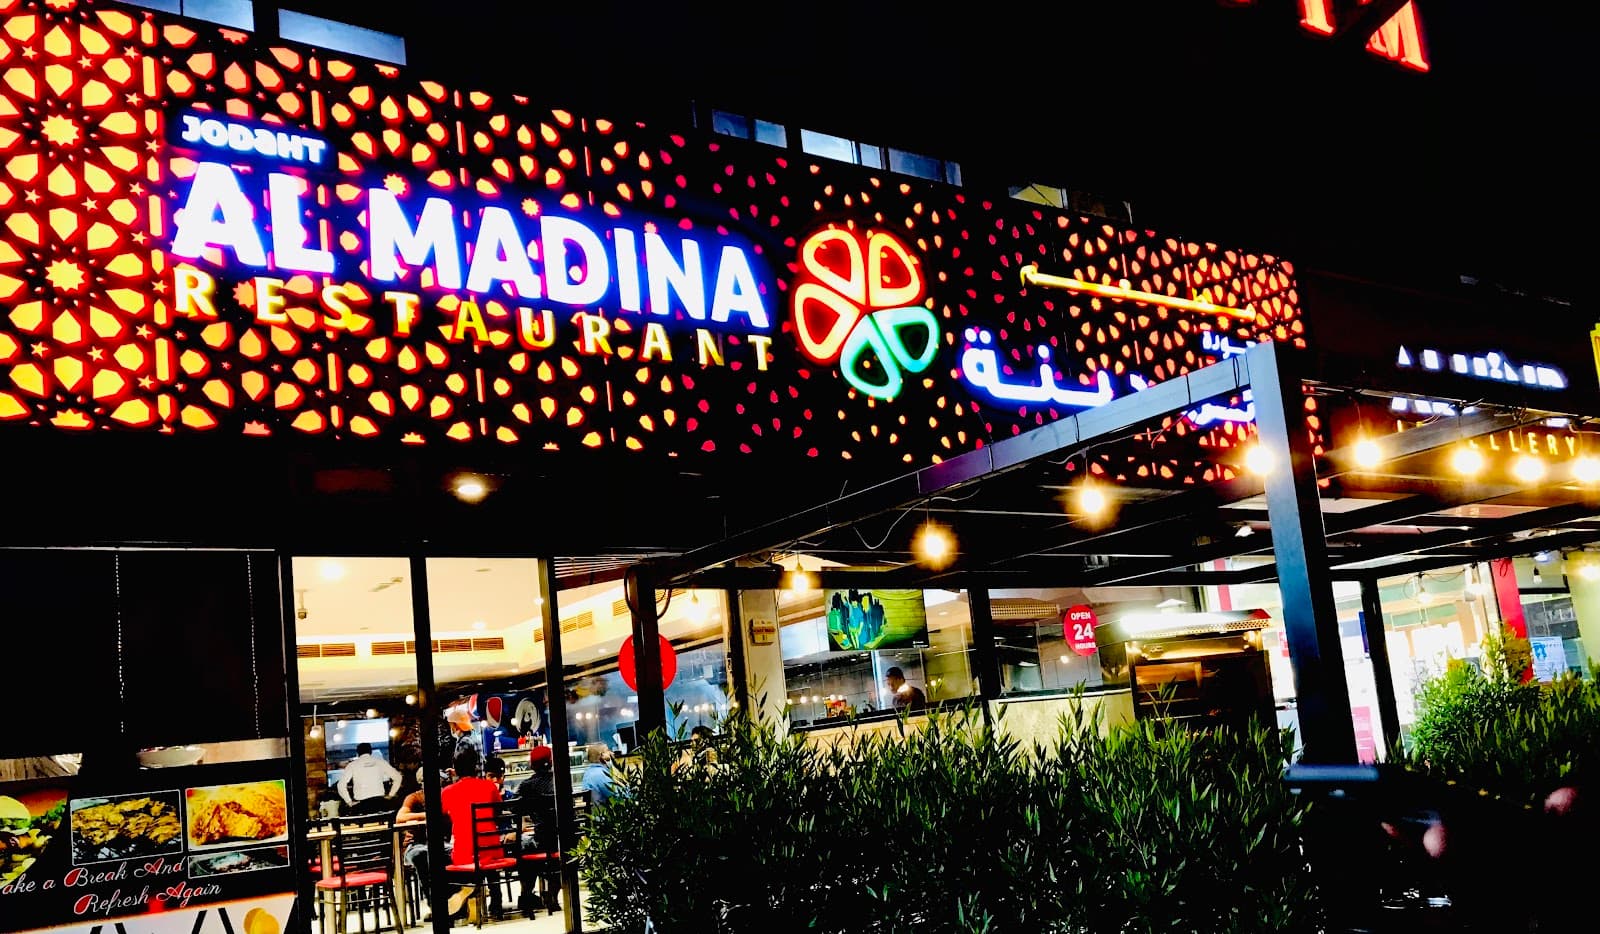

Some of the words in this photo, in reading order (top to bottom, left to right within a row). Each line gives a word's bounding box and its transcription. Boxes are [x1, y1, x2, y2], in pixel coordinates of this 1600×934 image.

[171, 160, 336, 274] AL
[368, 188, 770, 328] MADINA
[171, 267, 773, 372] RESTAURANT
[1070, 611, 1091, 620] OPEN
[1073, 623, 1094, 641] 24
[1075, 642, 1097, 650] HOURS
[2, 873, 36, 895] ake
[43, 879, 56, 890] a
[63, 861, 129, 887] Break
[133, 856, 188, 877] And
[73, 885, 150, 915] Refresh
[155, 880, 223, 908] Again
